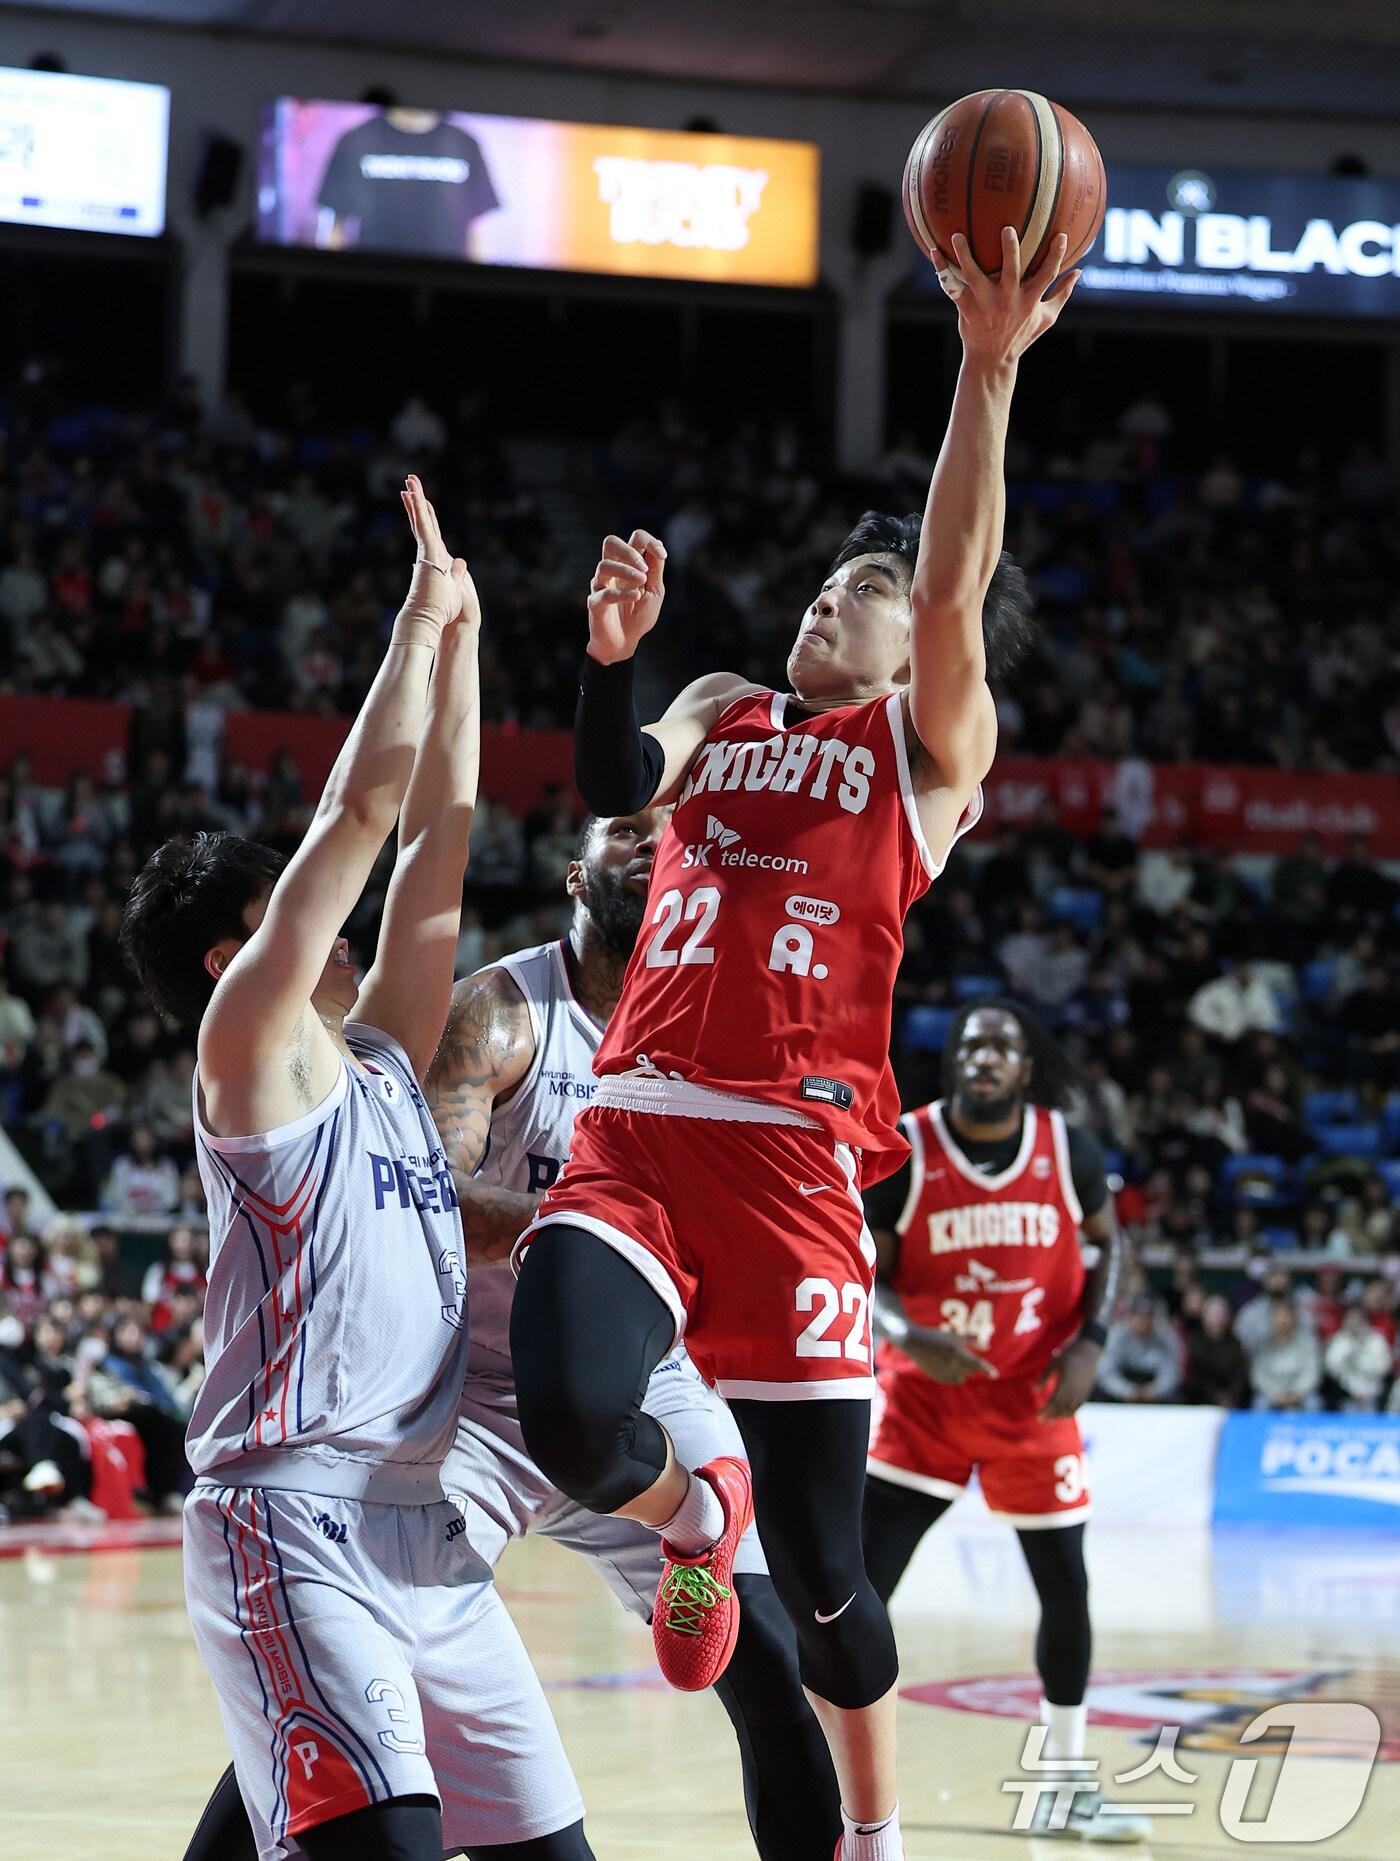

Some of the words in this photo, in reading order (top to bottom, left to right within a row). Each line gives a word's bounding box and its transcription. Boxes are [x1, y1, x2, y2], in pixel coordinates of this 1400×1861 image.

[1103, 207, 1185, 267] IN
[1195, 211, 1400, 278] BLAC
[681, 844, 714, 869] SK
[720, 848, 809, 875] telecom
[646, 886, 722, 969] 22
[793, 899, 834, 921] 에이닷
[928, 1201, 1060, 1256] KNIGHTS
[795, 1277, 869, 1364] 22
[938, 1298, 995, 1351] 34
[364, 1678, 426, 1756] 3
[293, 1740, 320, 1781] P
